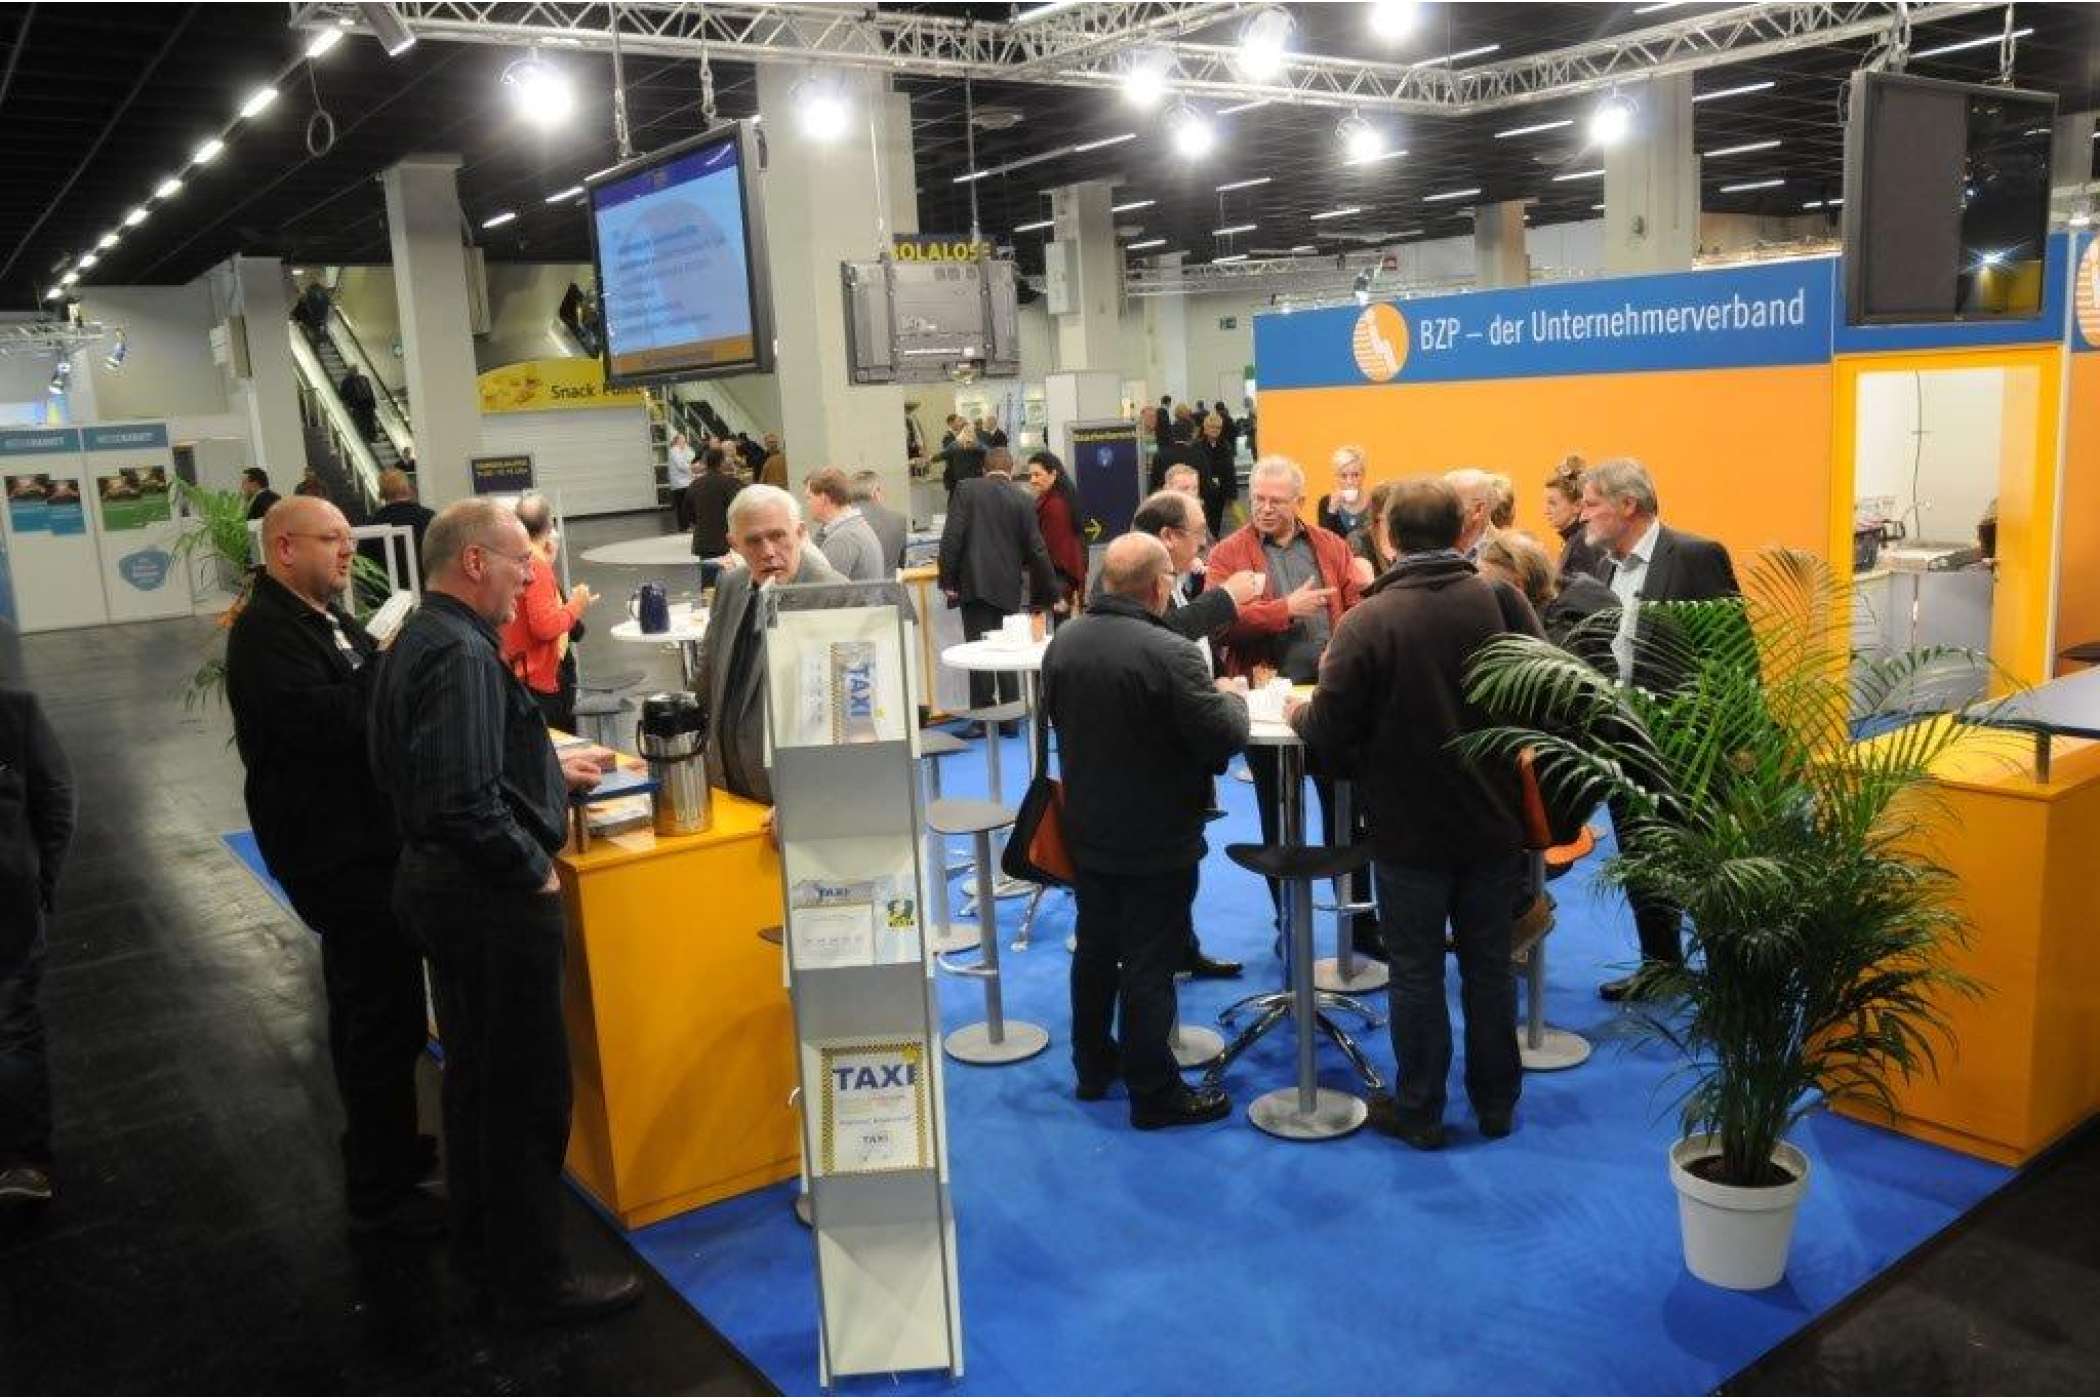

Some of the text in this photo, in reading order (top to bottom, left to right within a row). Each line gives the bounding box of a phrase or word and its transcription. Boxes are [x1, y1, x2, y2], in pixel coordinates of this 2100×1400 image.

[1420, 317, 1461, 350] BZP
[1489, 313, 1525, 346] der
[1532, 288, 1804, 342] Unternehmerverband
[832, 1064, 917, 1091] TAXI
